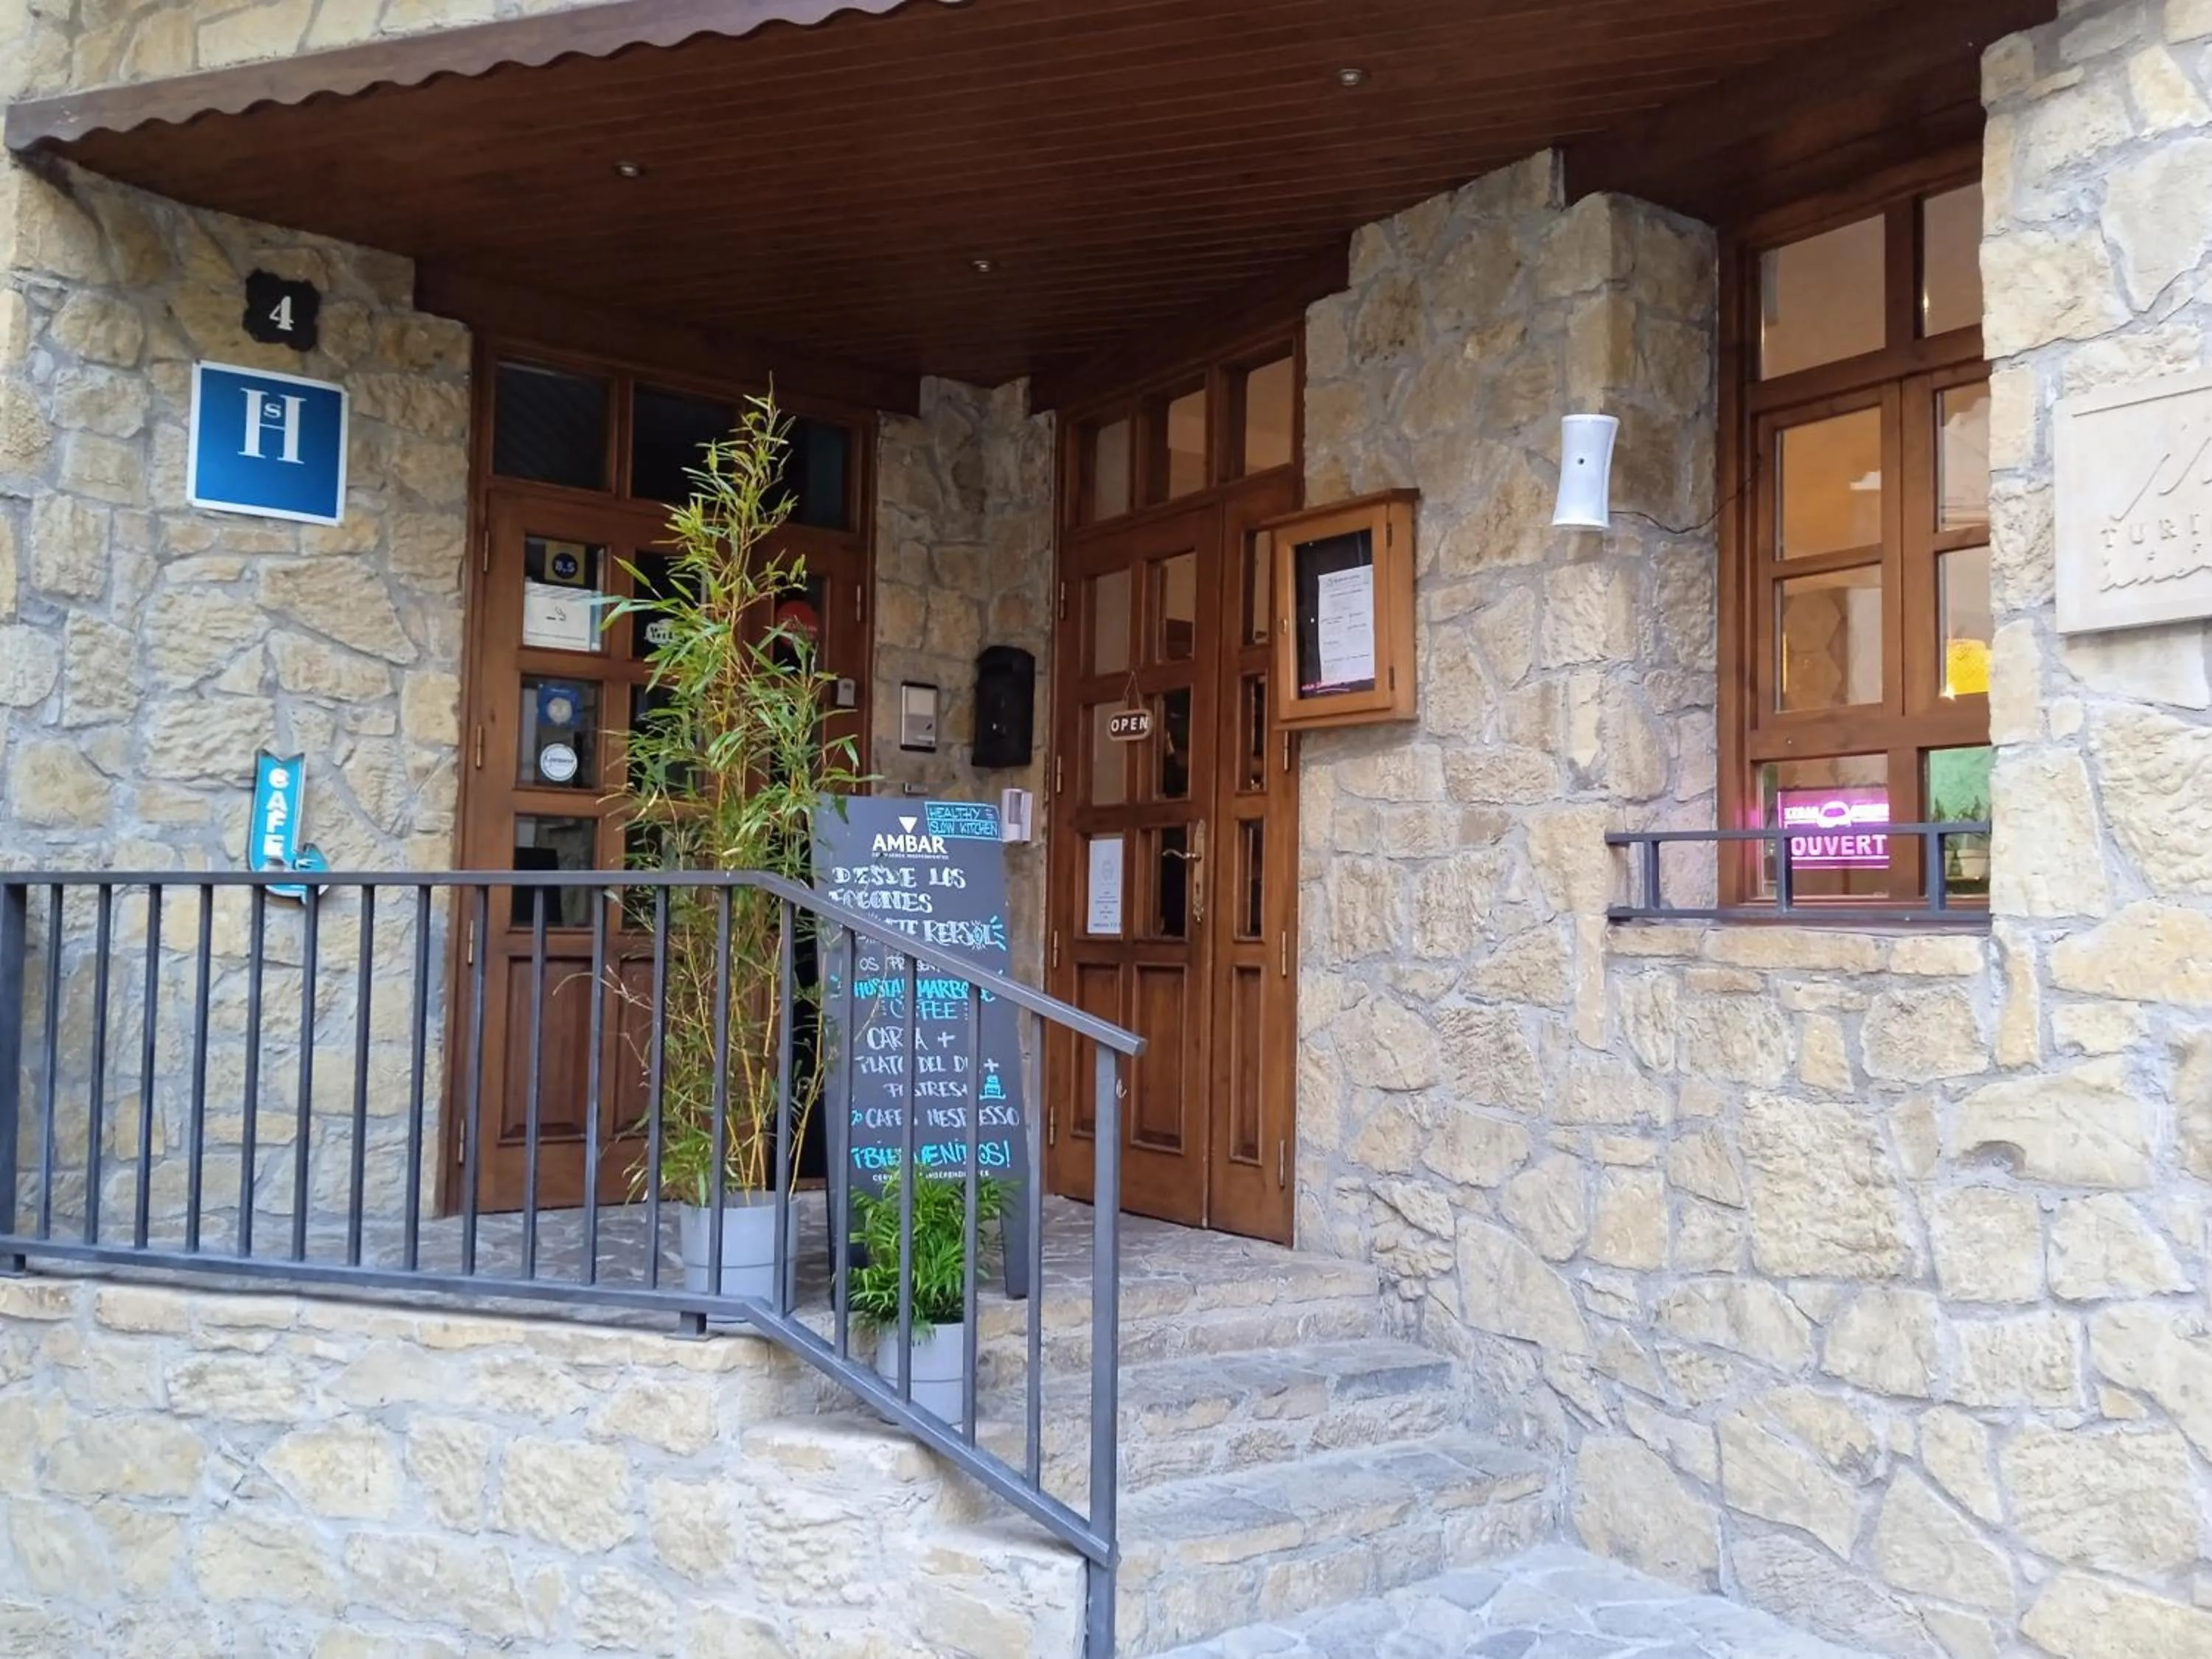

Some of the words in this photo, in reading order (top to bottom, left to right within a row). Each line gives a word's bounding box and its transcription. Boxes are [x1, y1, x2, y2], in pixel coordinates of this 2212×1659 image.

[268, 296, 294, 332] 4
[1110, 717, 1149, 732] OPEN
[930, 807, 981, 820] HEALTHY
[931, 821, 955, 834] SLOW
[960, 822, 998, 837] KITCHEN
[872, 833, 948, 854] AMBAR
[1791, 834, 1888, 856] OUVERT
[929, 866, 967, 888] LOS
[924, 919, 997, 947] REPSOL
[890, 998, 958, 1020] CFEE
[866, 1026, 929, 1051] CARA
[917, 1056, 946, 1074] DEL
[927, 1105, 1020, 1127] NESPESSO
